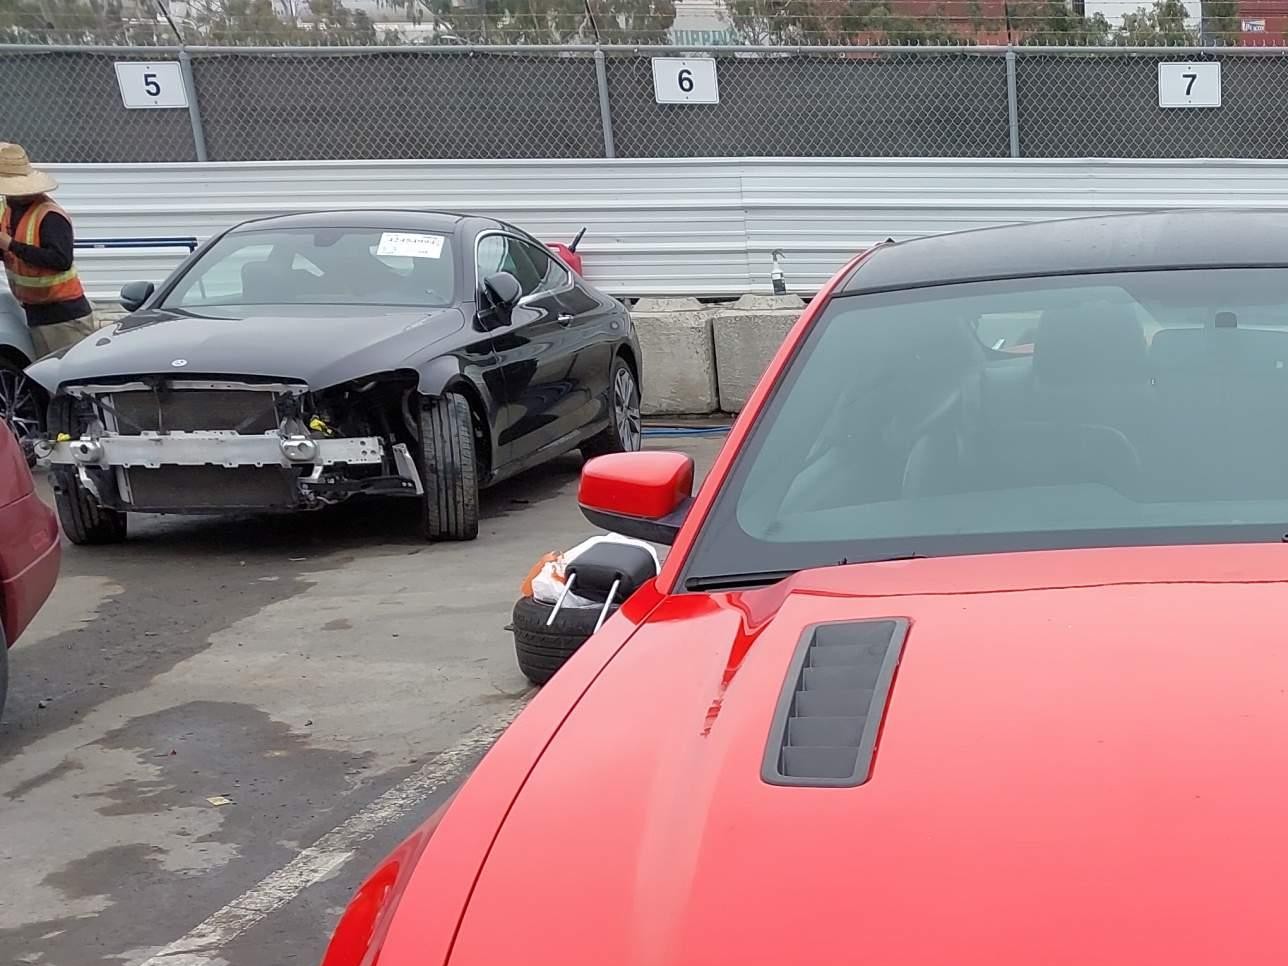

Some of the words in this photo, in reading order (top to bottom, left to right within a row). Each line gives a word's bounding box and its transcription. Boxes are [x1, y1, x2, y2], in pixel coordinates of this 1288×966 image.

[144, 74, 161, 97] 5
[678, 69, 694, 92] 6
[1182, 74, 1197, 96] 7
